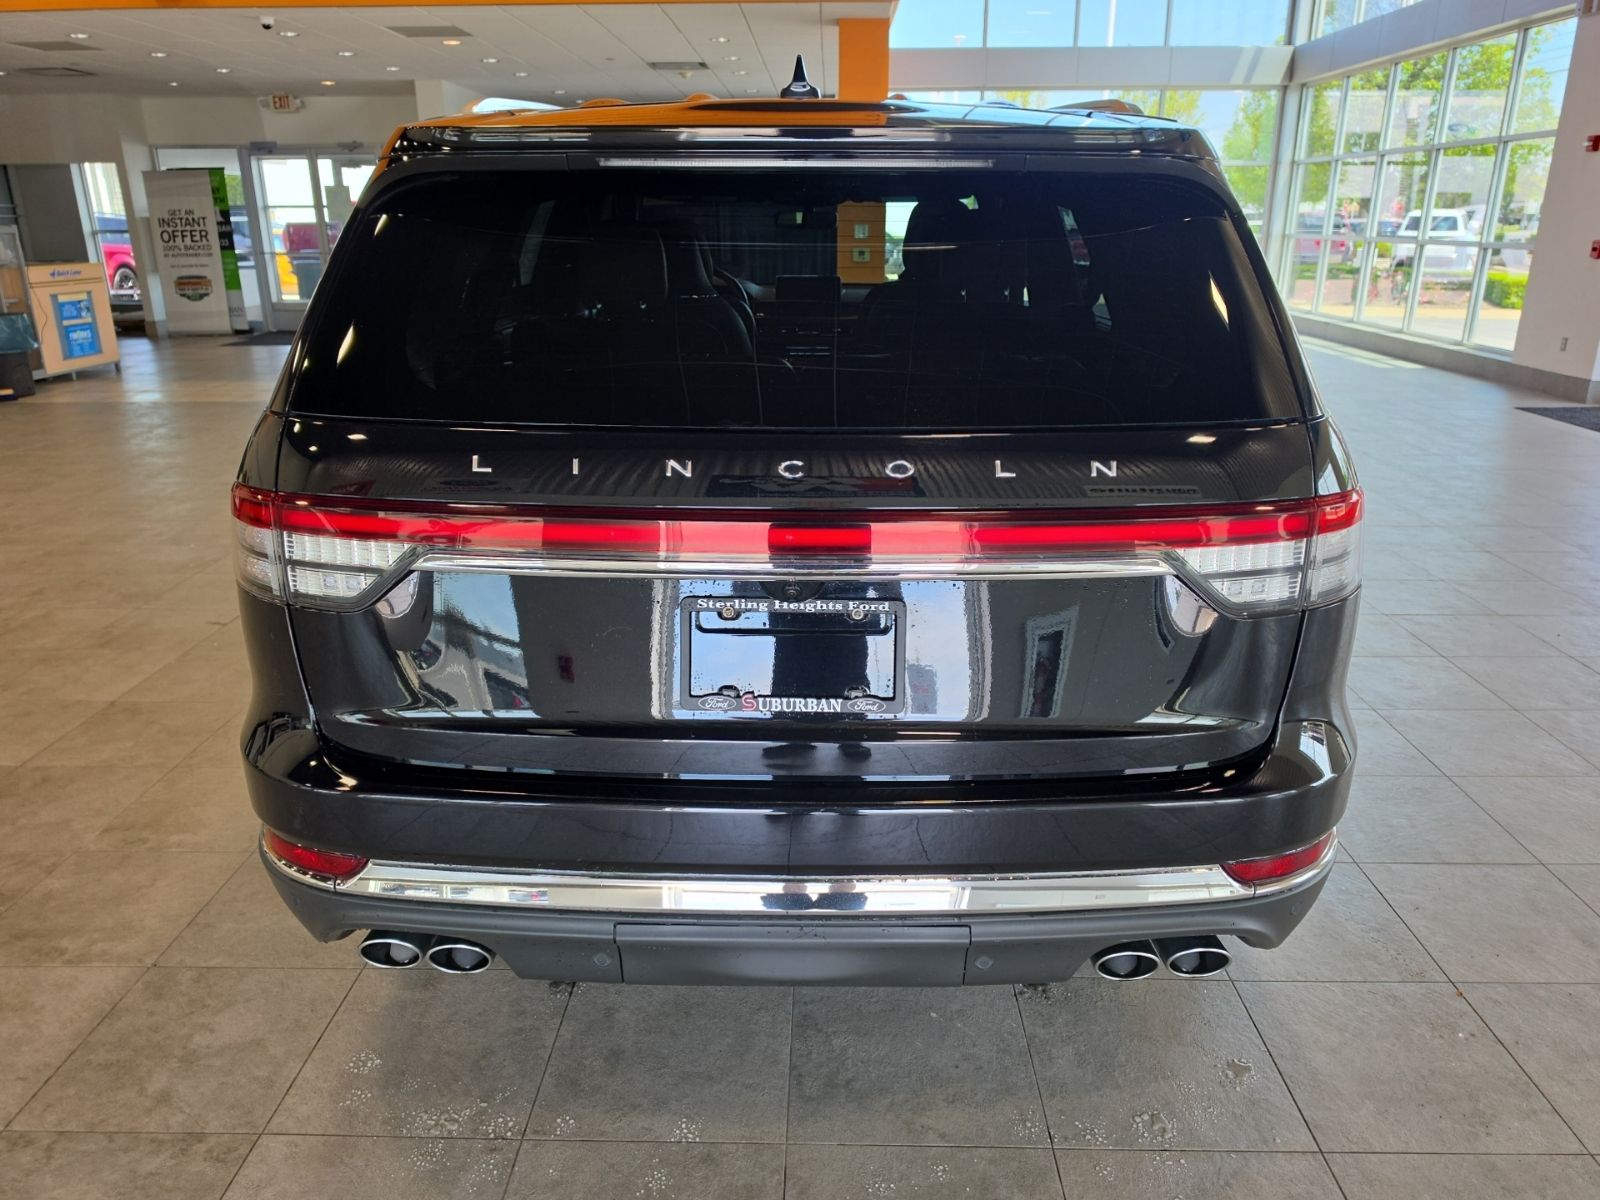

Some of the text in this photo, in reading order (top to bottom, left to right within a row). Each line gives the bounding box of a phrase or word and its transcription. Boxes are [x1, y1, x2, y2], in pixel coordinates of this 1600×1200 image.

[272, 95, 290, 110] EXIT
[158, 217, 207, 228] INSTANT
[160, 229, 210, 244] OFFER
[471, 454, 1118, 477] LINCOLN
[696, 598, 889, 612] Sterling Heights Ford
[704, 693, 879, 712] Ford SUBURBAN Ford
